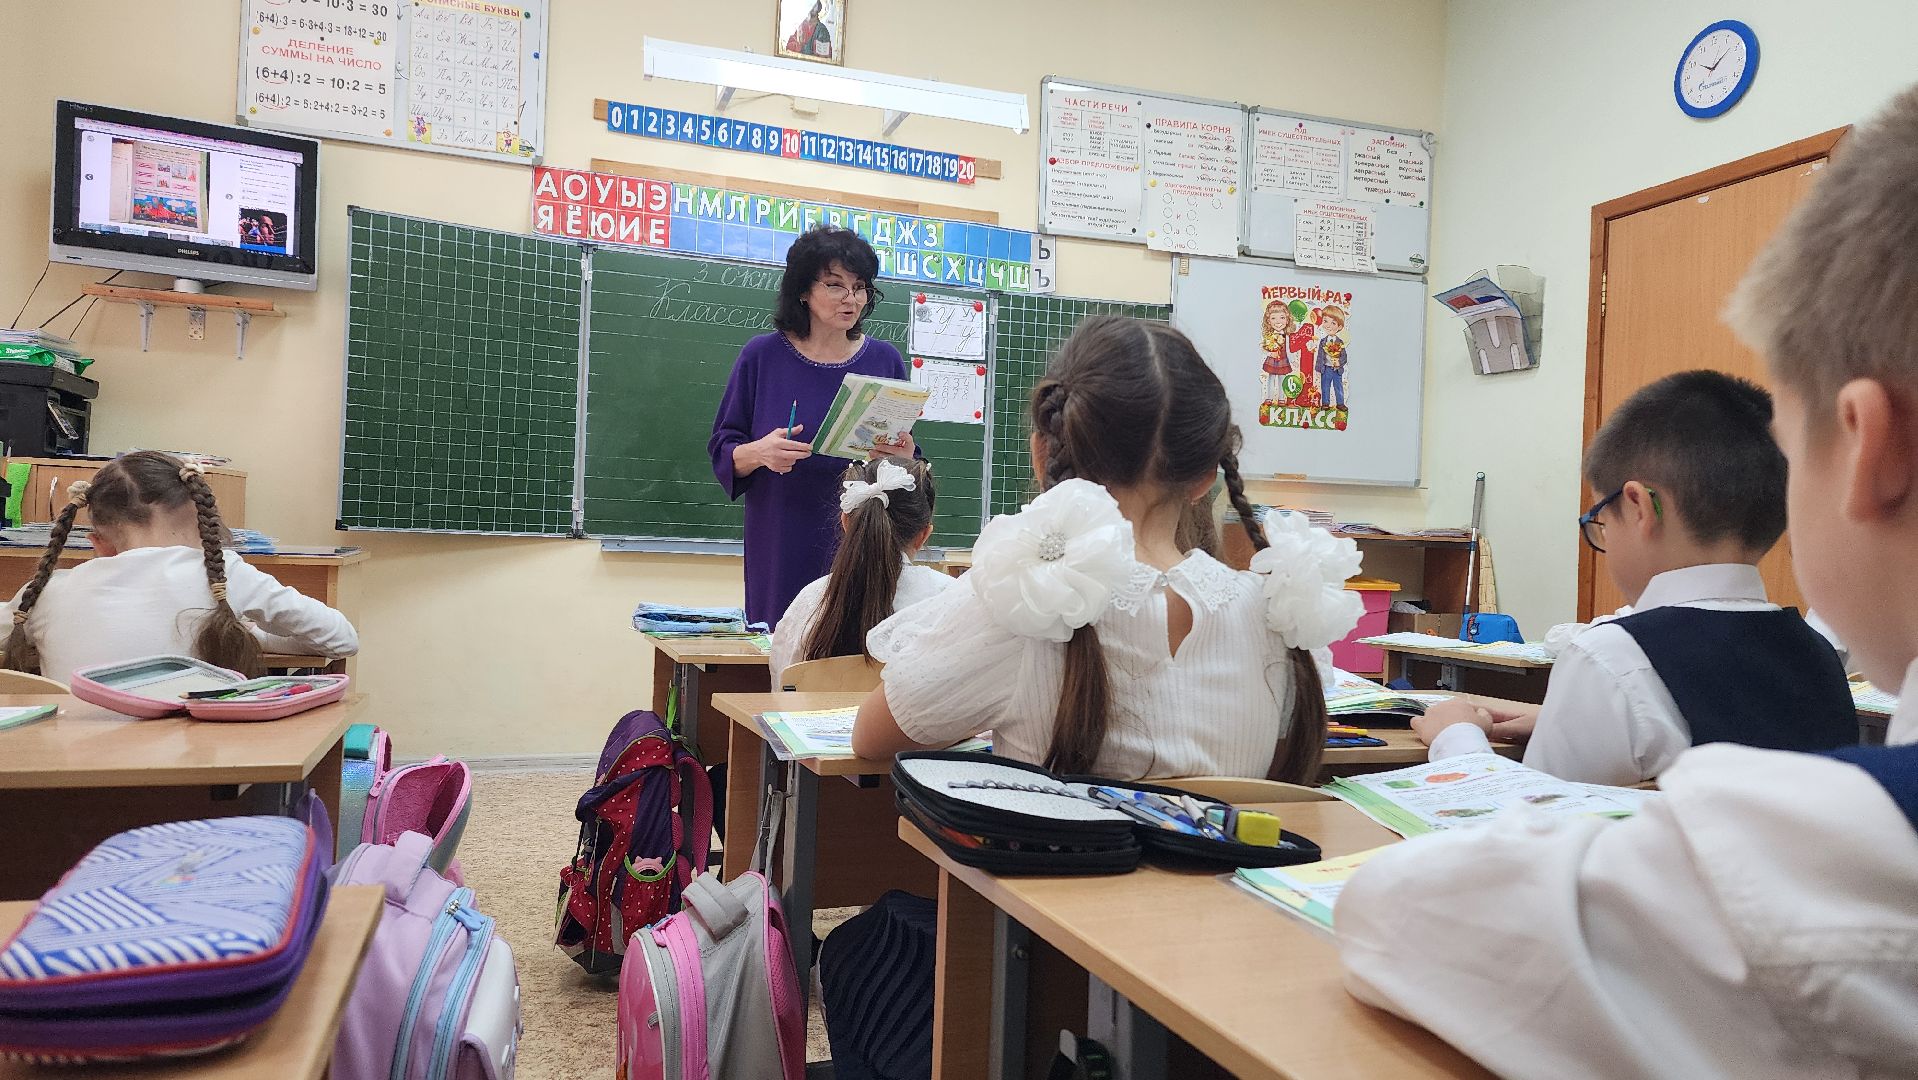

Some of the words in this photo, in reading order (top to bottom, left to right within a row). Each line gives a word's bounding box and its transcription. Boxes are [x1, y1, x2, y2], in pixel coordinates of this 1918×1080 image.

[372, 4, 388, 17] 30
[484, 4, 520, 18] БУКВЫ
[288, 39, 354, 56] ДЕЛЕНИЕ
[261, 45, 312, 61] СУММЫ
[316, 56, 334, 65] НА
[339, 57, 382, 71] ЧИСЛО
[331, 77, 360, 92] 10:2
[378, 83, 386, 95] 5
[1065, 97, 1099, 109] ЧАСТИ
[1101, 102, 1129, 113] РЕЧИ
[1155, 118, 1198, 130] ПРАВИЛА
[1201, 123, 1231, 134] КОРНЯ
[611, 106, 622, 128] 0
[630, 110, 638, 130] 1
[648, 112, 658, 133] 2
[666, 114, 675, 135] 3
[683, 117, 693, 138] 4
[700, 120, 710, 141] 5
[718, 122, 727, 143] 6
[735, 125, 745, 145] 7
[752, 128, 761, 149] 8
[769, 130, 778, 151] 9
[784, 133, 799, 153] 10
[803, 135, 817, 155] 11
[821, 138, 836, 159] 12
[839, 141, 853, 161] 13
[857, 143, 871, 165] 14
[875, 146, 889, 167] 15
[892, 149, 906, 170] 16
[910, 152, 924, 173] 17
[926, 155, 940, 175] 18
[943, 157, 957, 177] 19
[958, 160, 975, 180] 20
[536, 172, 558, 198] А
[564, 174, 587, 201] О
[594, 176, 614, 204] У
[621, 181, 643, 209] Ы
[649, 185, 667, 212] Э
[675, 186, 692, 215] Н
[699, 190, 722, 219] М
[726, 194, 746, 222] Л
[756, 198, 771, 224] Р
[779, 201, 798, 229] Й
[873, 217, 892, 246] Д
[898, 220, 917, 247] Ж
[924, 223, 938, 248] З
[536, 204, 554, 231] Я
[566, 204, 583, 235] Ё
[591, 212, 616, 239] Ю
[619, 215, 640, 242] И
[650, 219, 665, 245] Е
[896, 251, 918, 276] Ш
[923, 254, 938, 279] С
[946, 256, 962, 281] Х
[968, 260, 985, 287] Ц
[991, 262, 1005, 287] Ч
[1009, 265, 1031, 292] Щ
[1035, 268, 1051, 289] Ъ
[1261, 285, 1322, 301] ПЕРВЫЙ
[1269, 407, 1338, 429] КЛАСС
